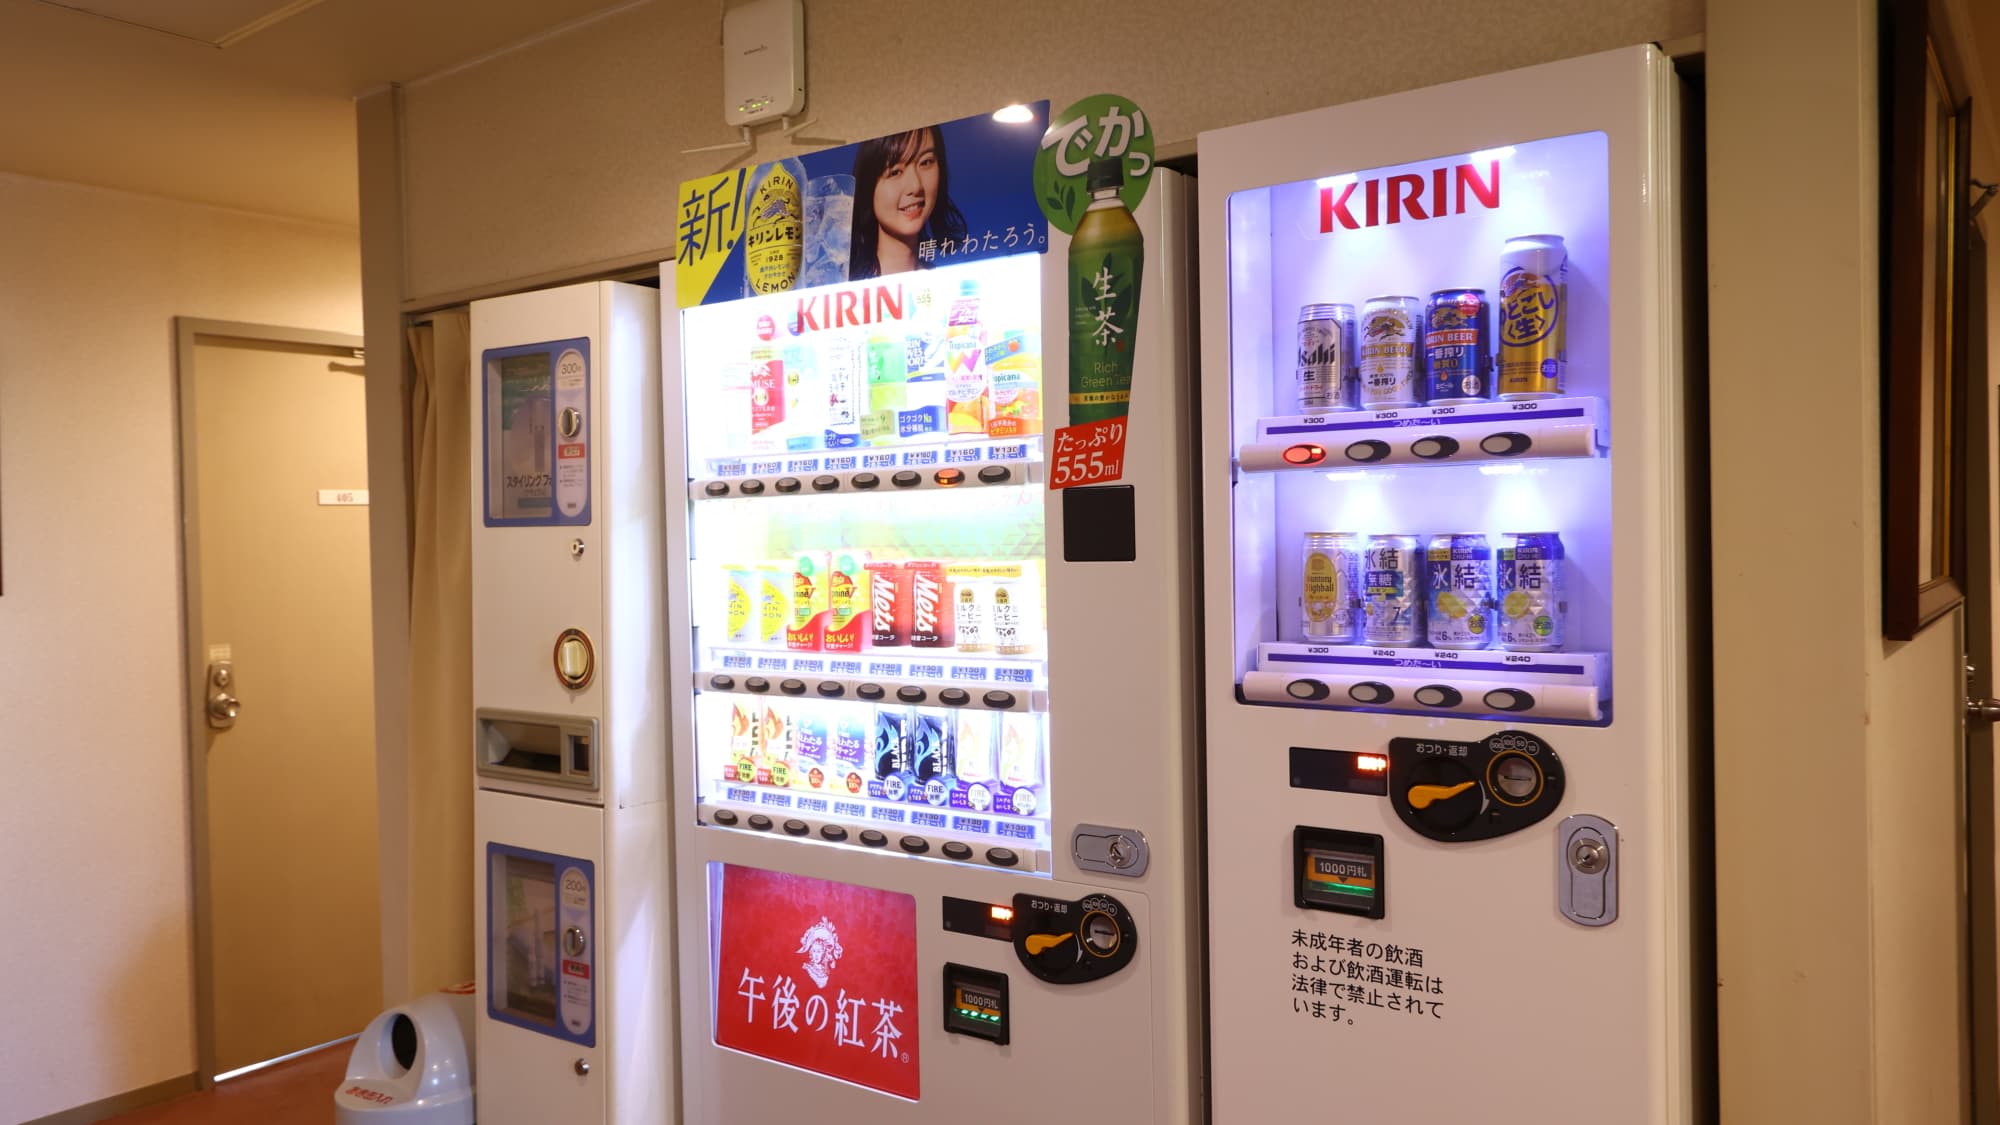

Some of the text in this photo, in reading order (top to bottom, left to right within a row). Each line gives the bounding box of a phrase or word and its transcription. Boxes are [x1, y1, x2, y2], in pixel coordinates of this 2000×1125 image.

[1041, 106, 1151, 176] でかっ
[760, 176, 793, 194] KIRIN
[1320, 160, 1500, 233] KIRIN
[679, 168, 746, 266] 新!
[749, 226, 801, 248] キリンレモン
[918, 223, 1045, 261] 晴れわたろう。
[755, 273, 796, 293] LEMON
[797, 284, 903, 334] KIRIN
[1092, 267, 1124, 346] 生茶
[1447, 332, 1473, 341] BEER
[1094, 362, 1120, 374] Rich
[1081, 375, 1113, 388] Green
[1057, 424, 1123, 453] たっぷり
[1364, 548, 1399, 569] 氷結
[1433, 563, 1475, 589] 氷結
[1305, 583, 1334, 593] Highball
[874, 574, 895, 632] Mets
[915, 574, 938, 633] Mets
[1416, 743, 1468, 757] おつり・返却
[886, 780, 901, 789] FIRE
[927, 784, 943, 793] FIRE
[878, 807, 898, 815] ¥130
[919, 812, 938, 820] ¥130
[961, 818, 982, 826] ¥130
[1005, 823, 1026, 831] ¥130
[1319, 861, 1367, 877] 1000円札
[1291, 929, 1423, 968] 未成年者の飲酒
[1292, 952, 1444, 995] および飲酒運転は
[1292, 974, 1444, 1019] 法律で禁止されて
[737, 967, 903, 1059] 午後の紅茶
[1293, 997, 1354, 1026] います。
